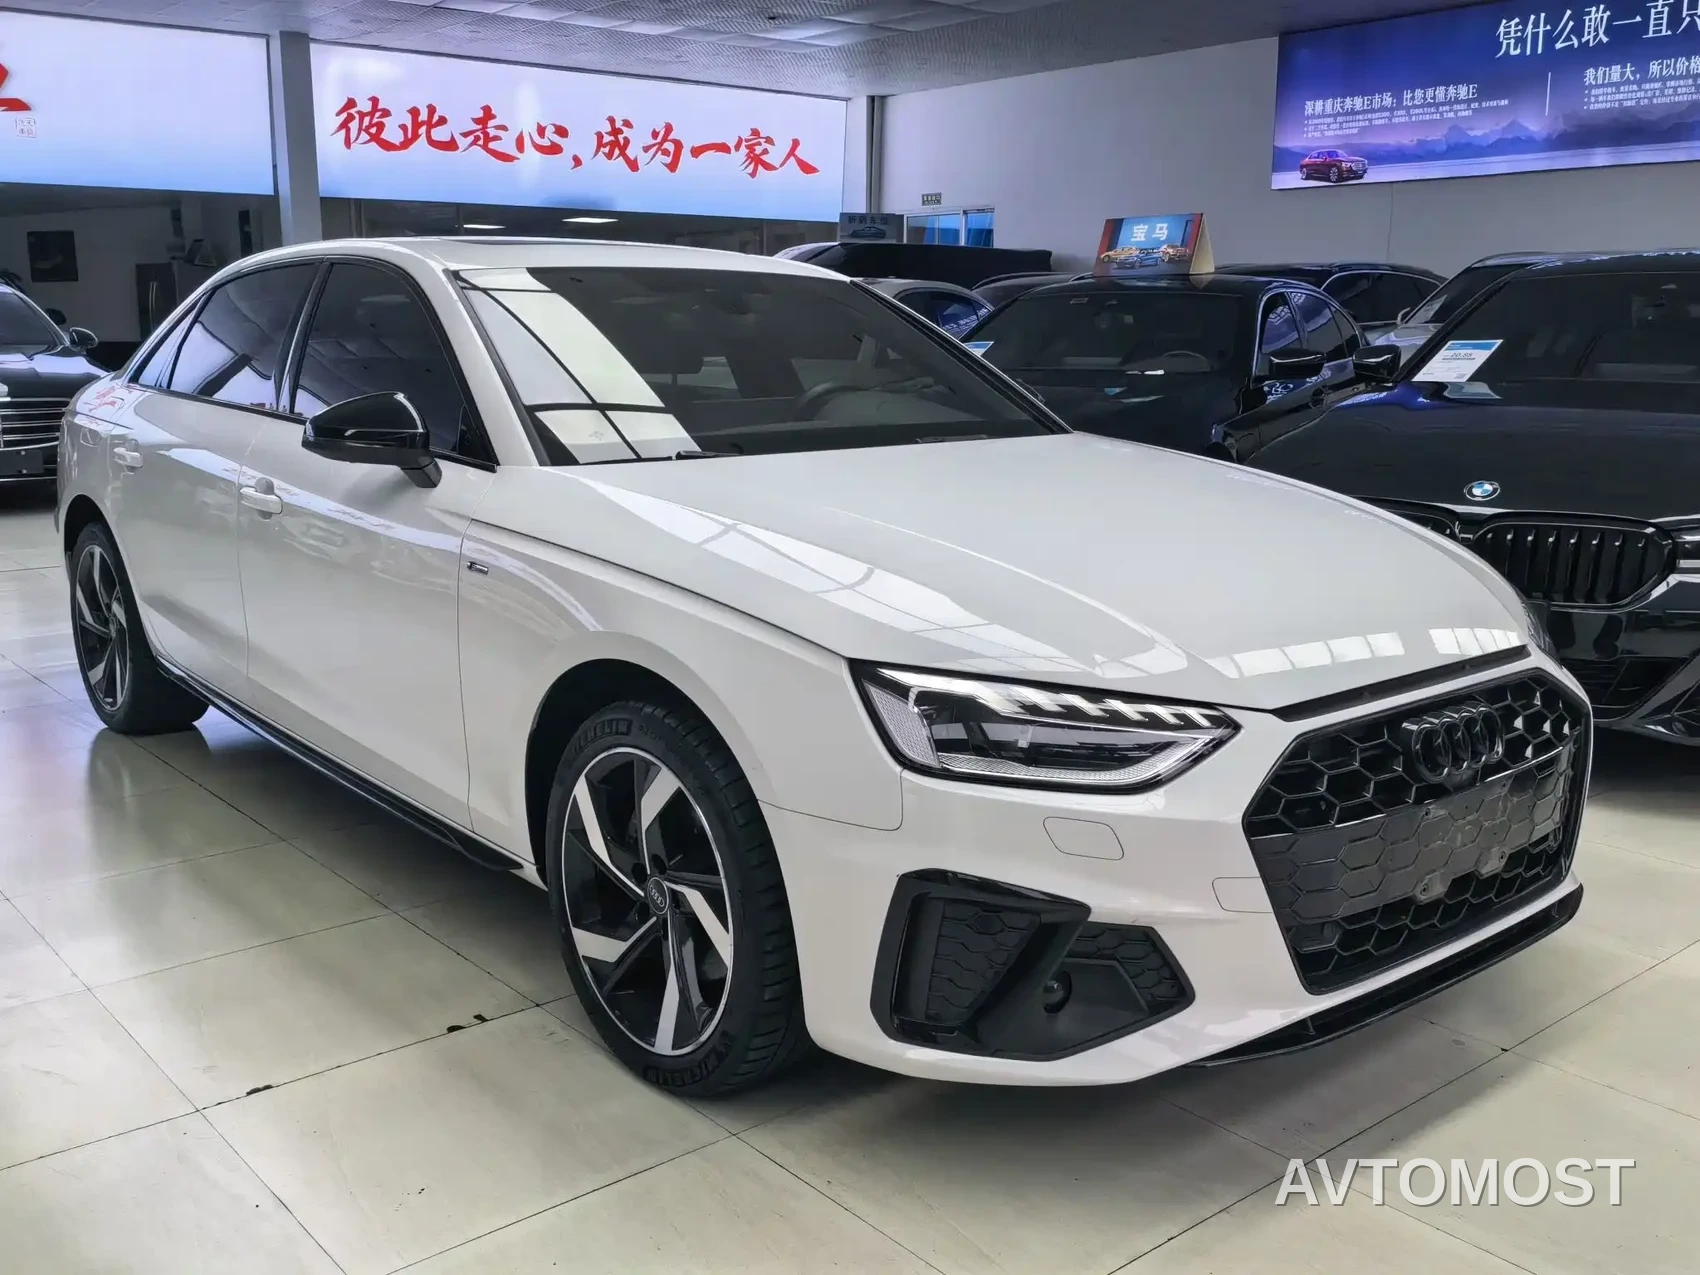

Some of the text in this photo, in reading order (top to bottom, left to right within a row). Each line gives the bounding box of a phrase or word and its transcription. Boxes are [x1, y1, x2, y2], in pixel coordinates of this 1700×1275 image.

[330, 96, 820, 178] 彼此走心，成为一家人
[1130, 223, 1169, 242] 宝马
